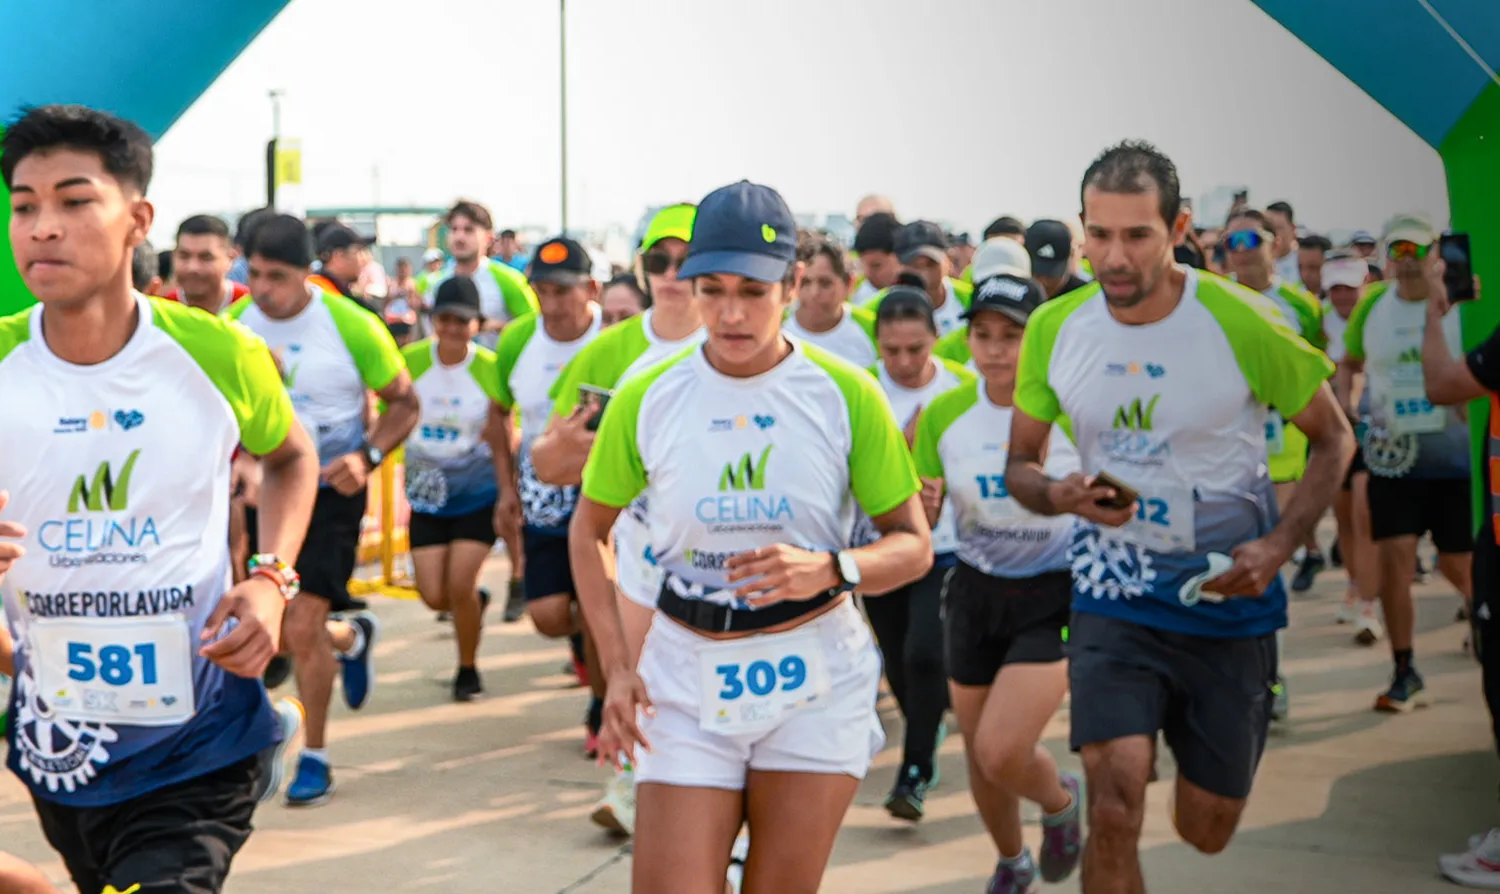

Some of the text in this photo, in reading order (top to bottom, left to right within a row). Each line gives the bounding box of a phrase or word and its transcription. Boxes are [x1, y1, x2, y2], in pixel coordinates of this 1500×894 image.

[695, 494, 794, 524] CELINA
[38, 516, 160, 552] CELINA
[67, 641, 158, 686] 581
[715, 654, 806, 700] 309
